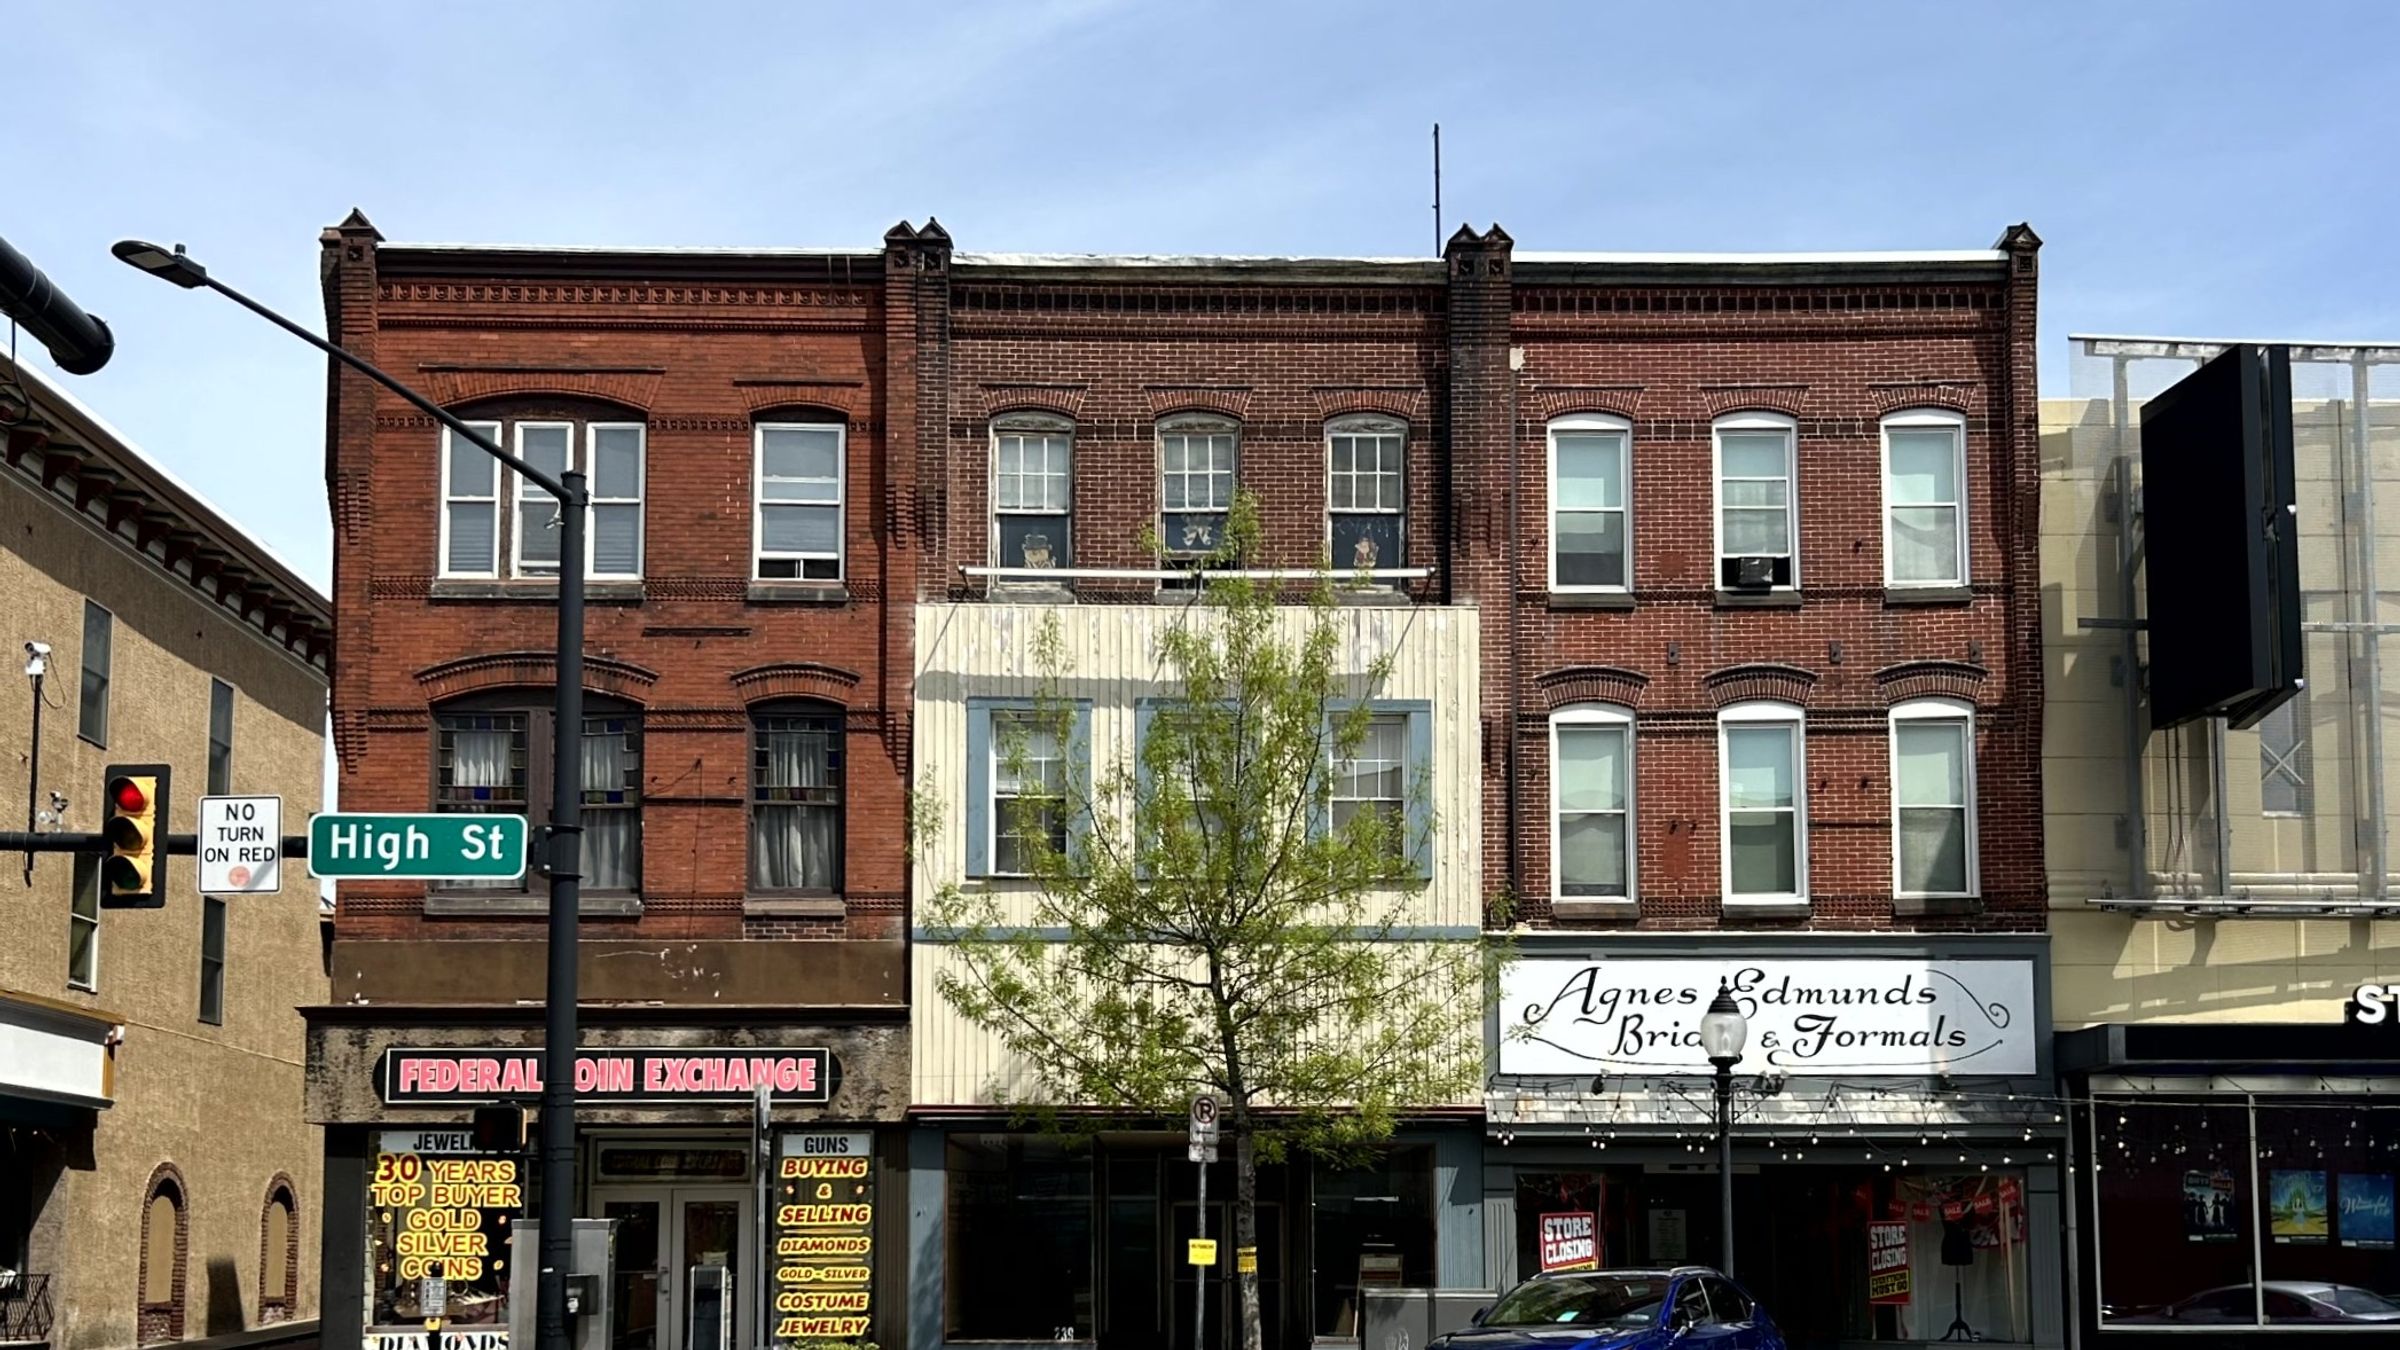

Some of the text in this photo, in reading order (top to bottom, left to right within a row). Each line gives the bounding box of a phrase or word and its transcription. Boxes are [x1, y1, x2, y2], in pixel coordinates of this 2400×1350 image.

[225, 803, 256, 821] NO
[217, 826, 264, 842] TURN
[204, 847, 276, 863] ON RED
[331, 823, 504, 871] High St
[1523, 966, 1938, 1025] Agnes Edmunds
[1760, 1030, 1782, 1049] &
[1792, 1013, 1968, 1058] Formals
[399, 1057, 817, 1092] FEDERAL OIN EXCHANGE
[804, 1136, 849, 1154] GUNS
[377, 1154, 515, 1182] 30 YEARS
[782, 1158, 868, 1178] BUYING
[372, 1184, 521, 1207] TOP BUYER
[816, 1183, 832, 1199] &
[1944, 1205, 1962, 1216] SALE
[1974, 1198, 1991, 1209] SALE
[407, 1208, 481, 1231] GOLD
[778, 1205, 871, 1226] SELLING
[1544, 1216, 1592, 1242] STORE
[1871, 1225, 1906, 1249] STORE
[398, 1232, 488, 1256] SILVER
[778, 1237, 870, 1254] DIAMONDS
[1545, 1239, 1593, 1264] CLOSING
[1871, 1246, 1906, 1271] CLOSING
[777, 1293, 869, 1311] COSTUME
[776, 1317, 869, 1336] JEWELRY
